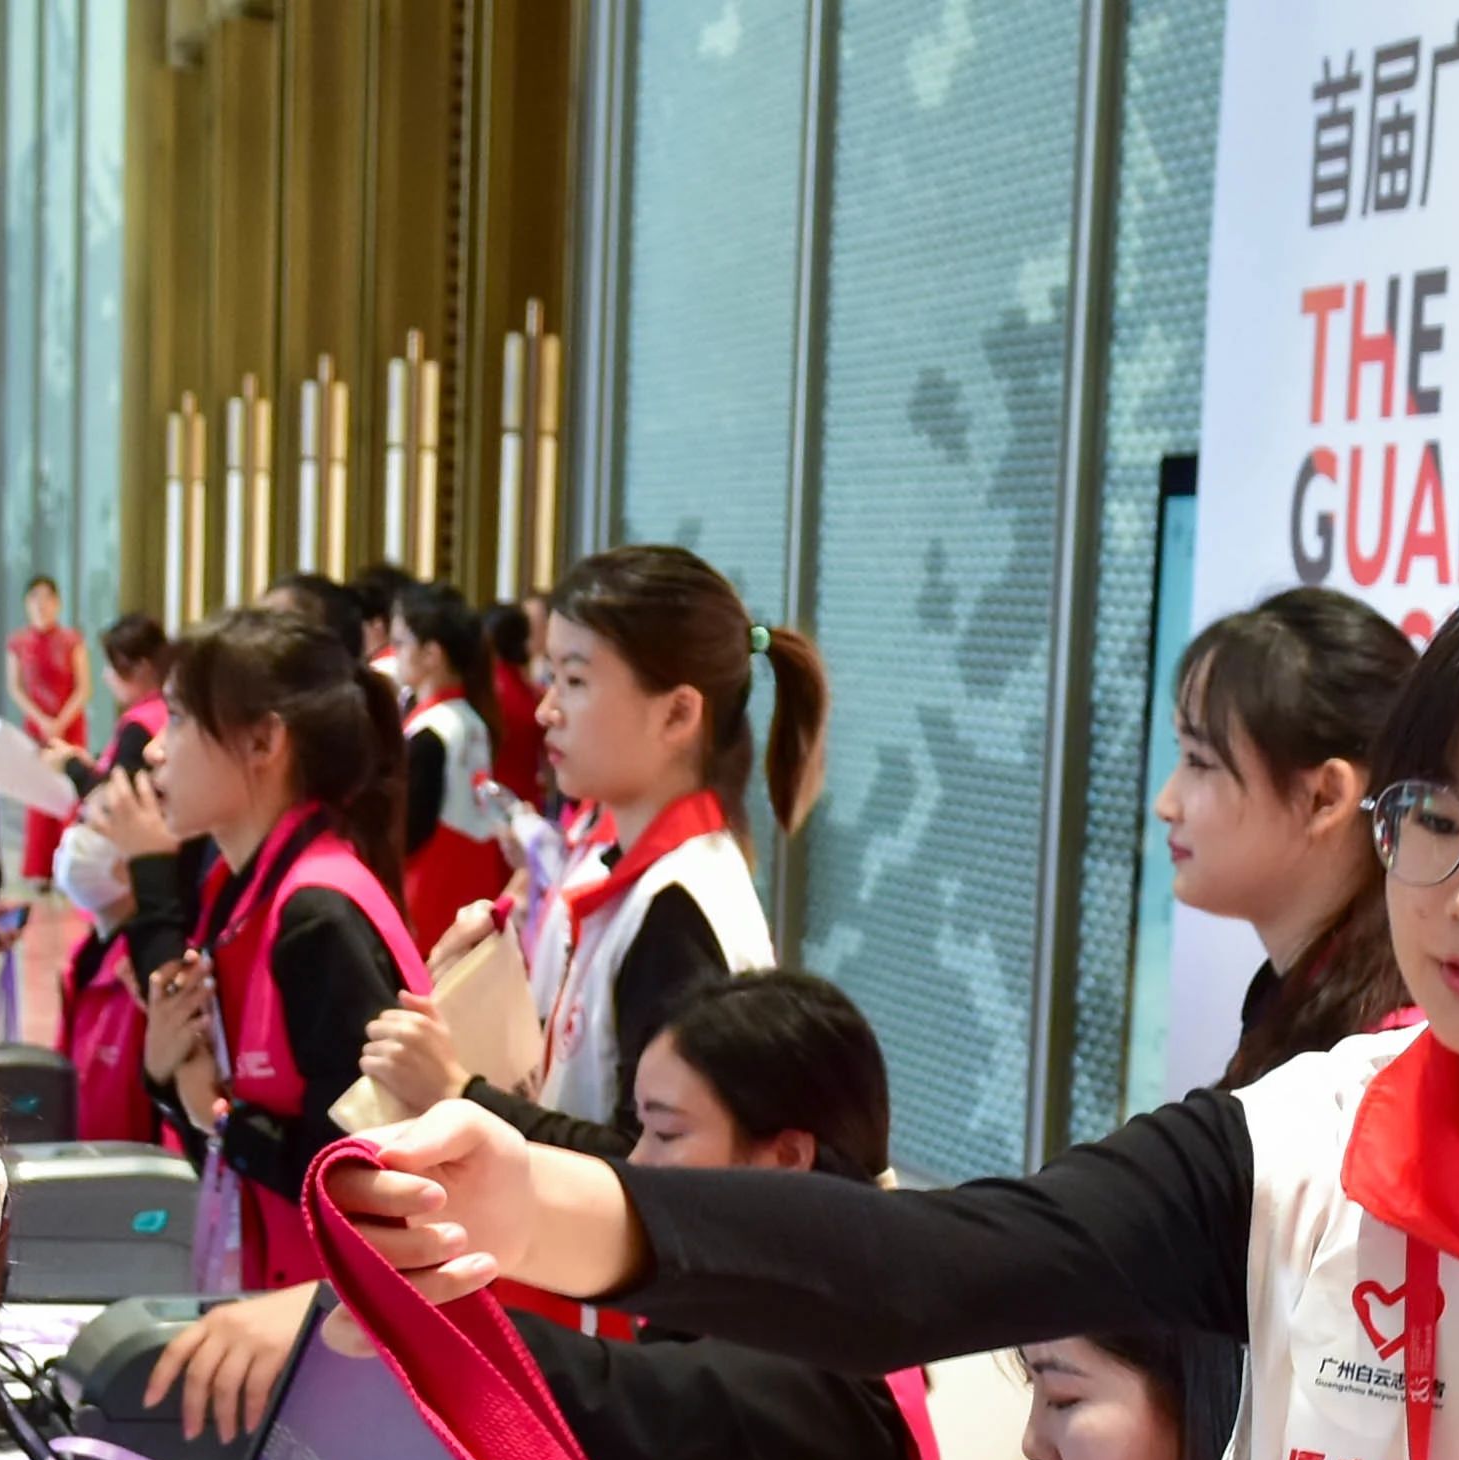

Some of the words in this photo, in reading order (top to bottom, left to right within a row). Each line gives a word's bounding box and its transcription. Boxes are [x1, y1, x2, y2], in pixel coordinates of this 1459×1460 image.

[1300, 267, 1448, 424] THE
[1314, 1378, 1366, 1396] Guangzhou
[1319, 1357, 1445, 1399] 广州白云志者
